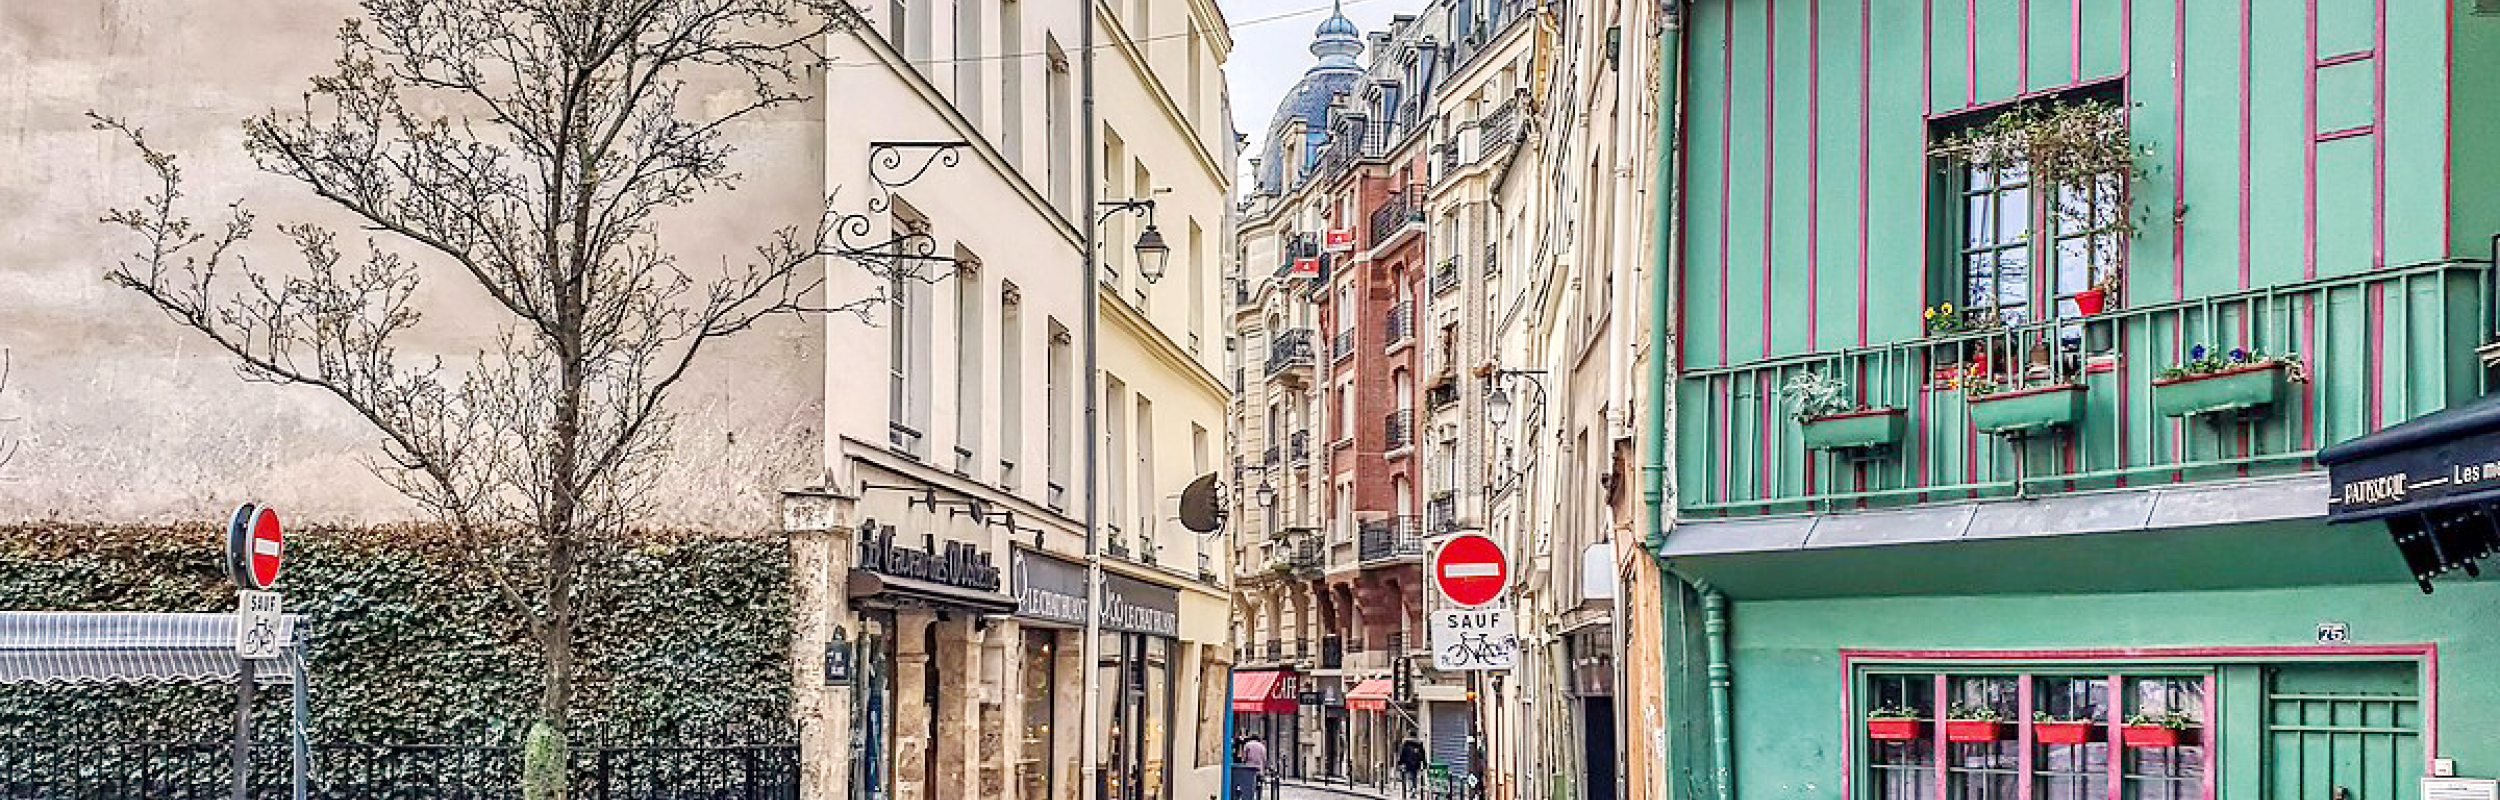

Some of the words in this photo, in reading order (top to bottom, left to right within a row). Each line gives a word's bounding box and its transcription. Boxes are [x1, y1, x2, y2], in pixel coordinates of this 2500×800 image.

[2454, 464, 2480, 484] Les
[251, 595, 276, 611] SAUF
[1447, 612, 1500, 628] SAUF
